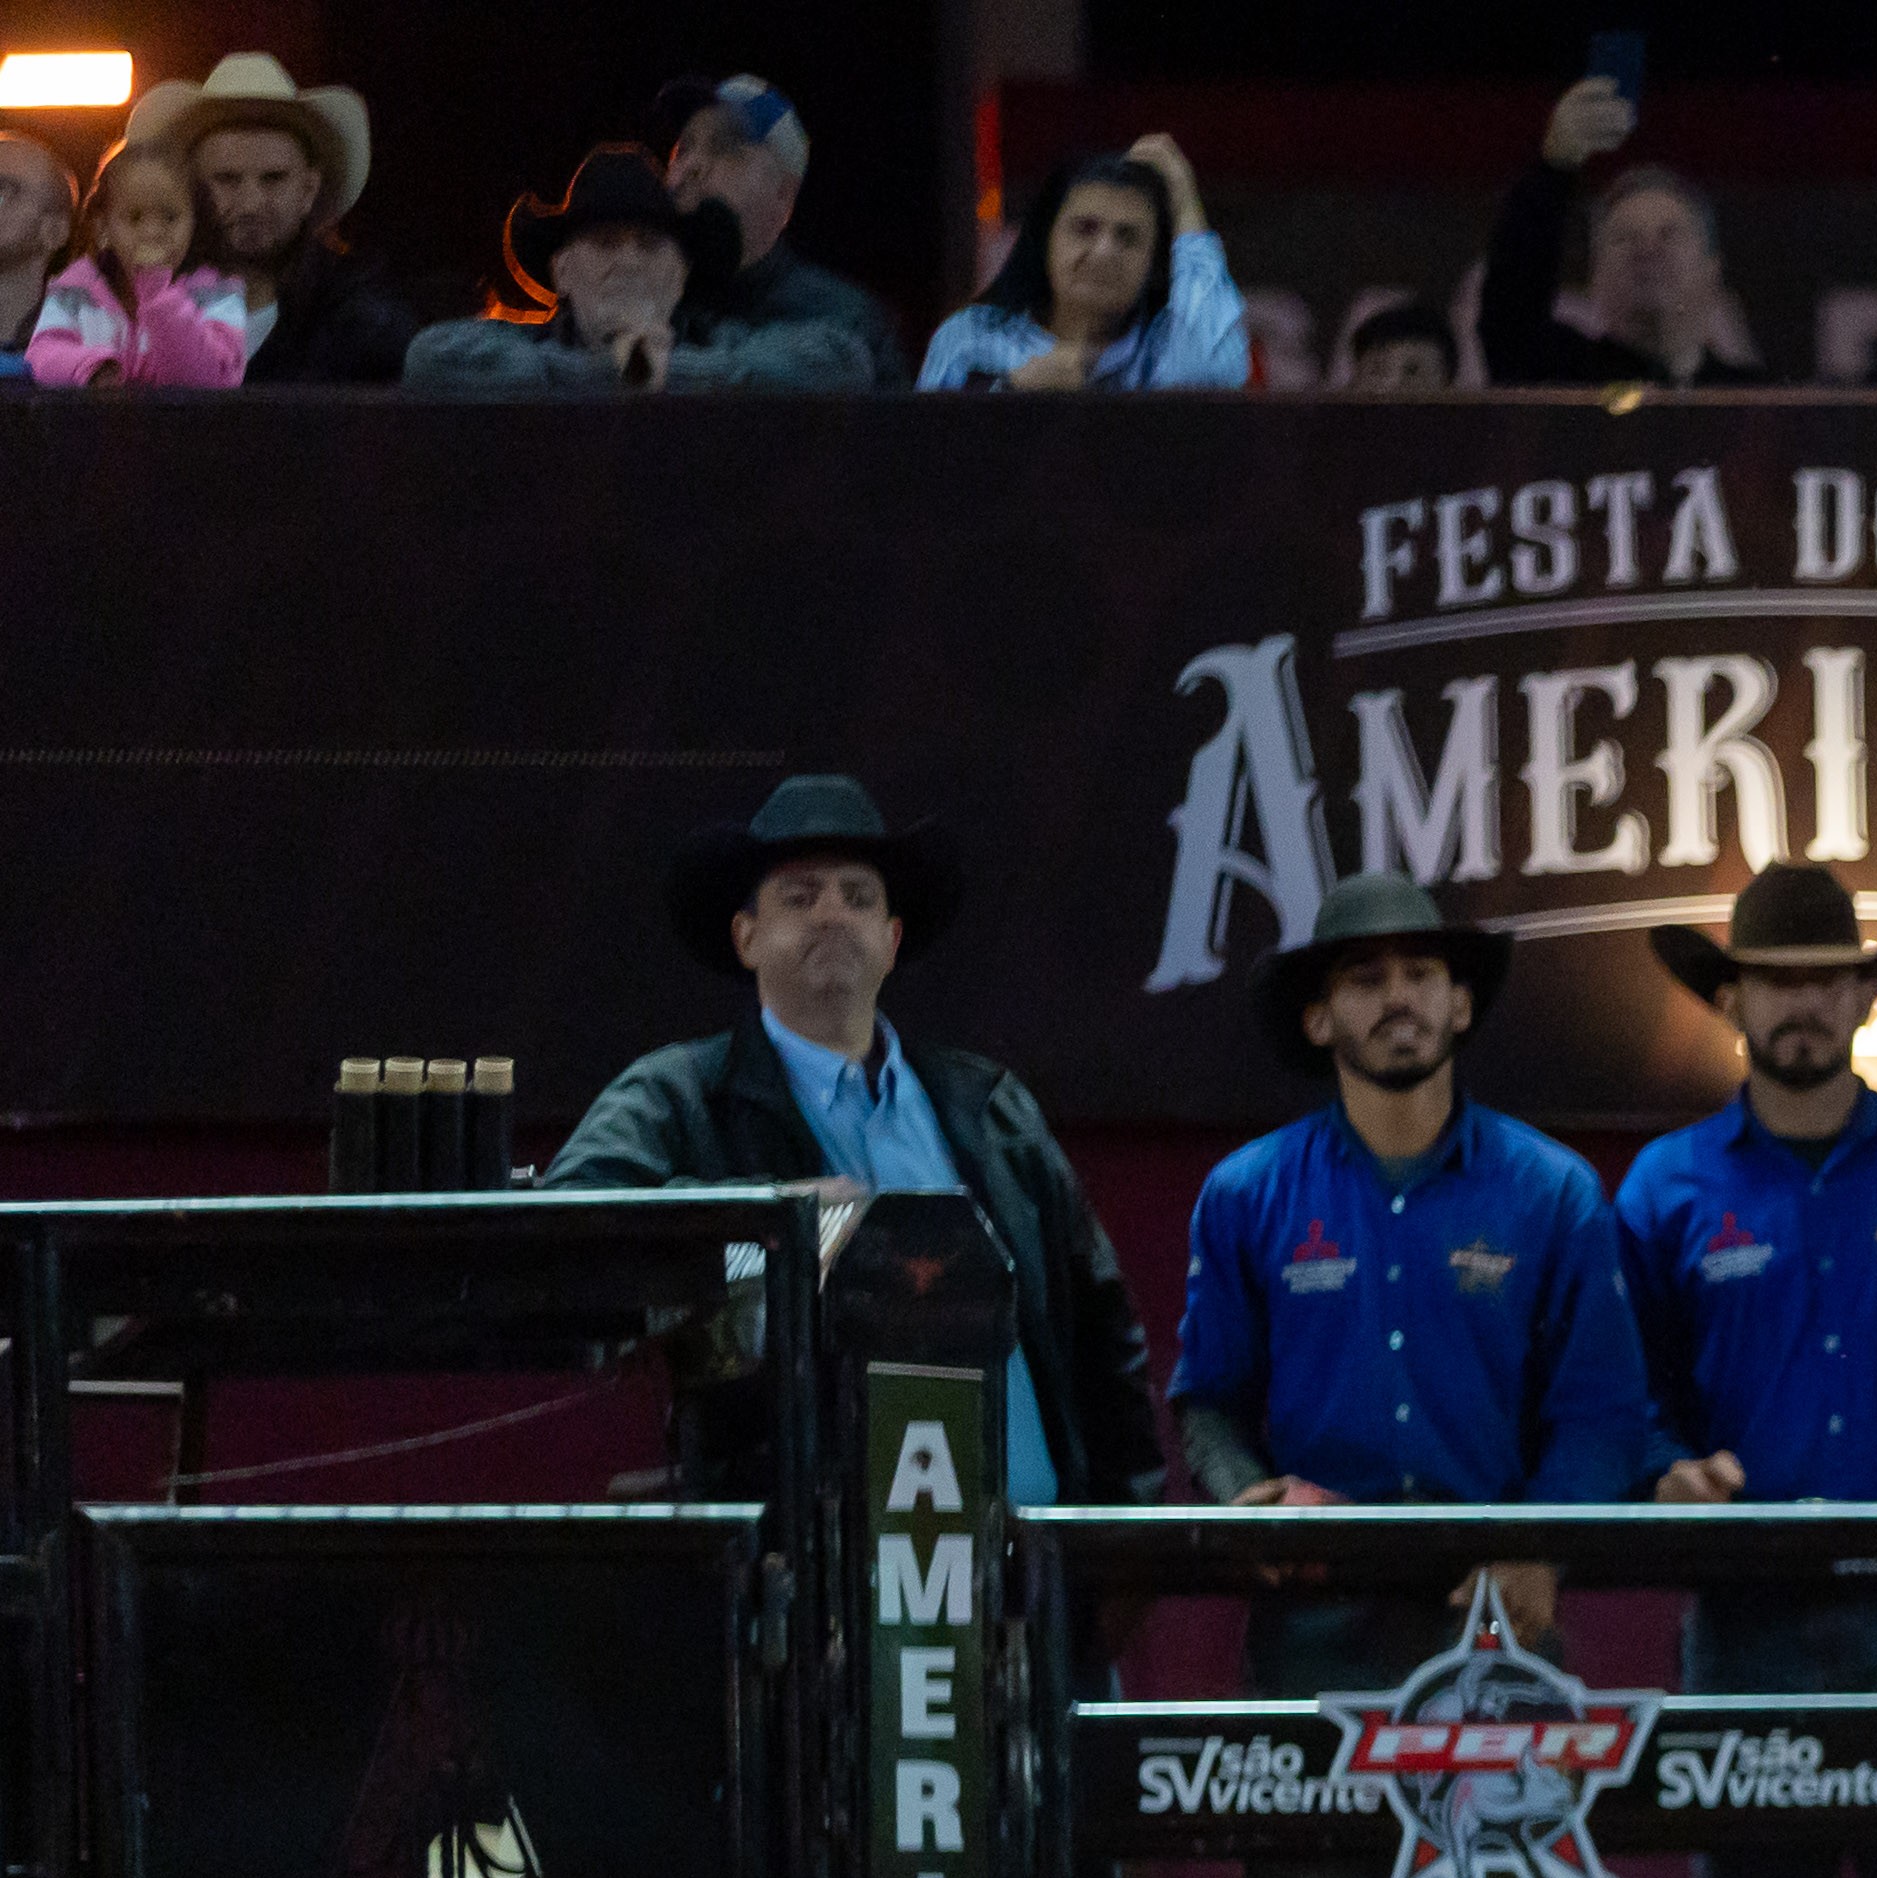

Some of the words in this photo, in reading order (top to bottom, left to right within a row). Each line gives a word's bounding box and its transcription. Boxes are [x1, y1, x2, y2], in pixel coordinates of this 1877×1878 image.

[1359, 466, 1741, 621] FESTA
[1138, 1735, 1223, 1815] SV
[1368, 1723, 1622, 1766] PBR
[1656, 1728, 1743, 1810] SV
